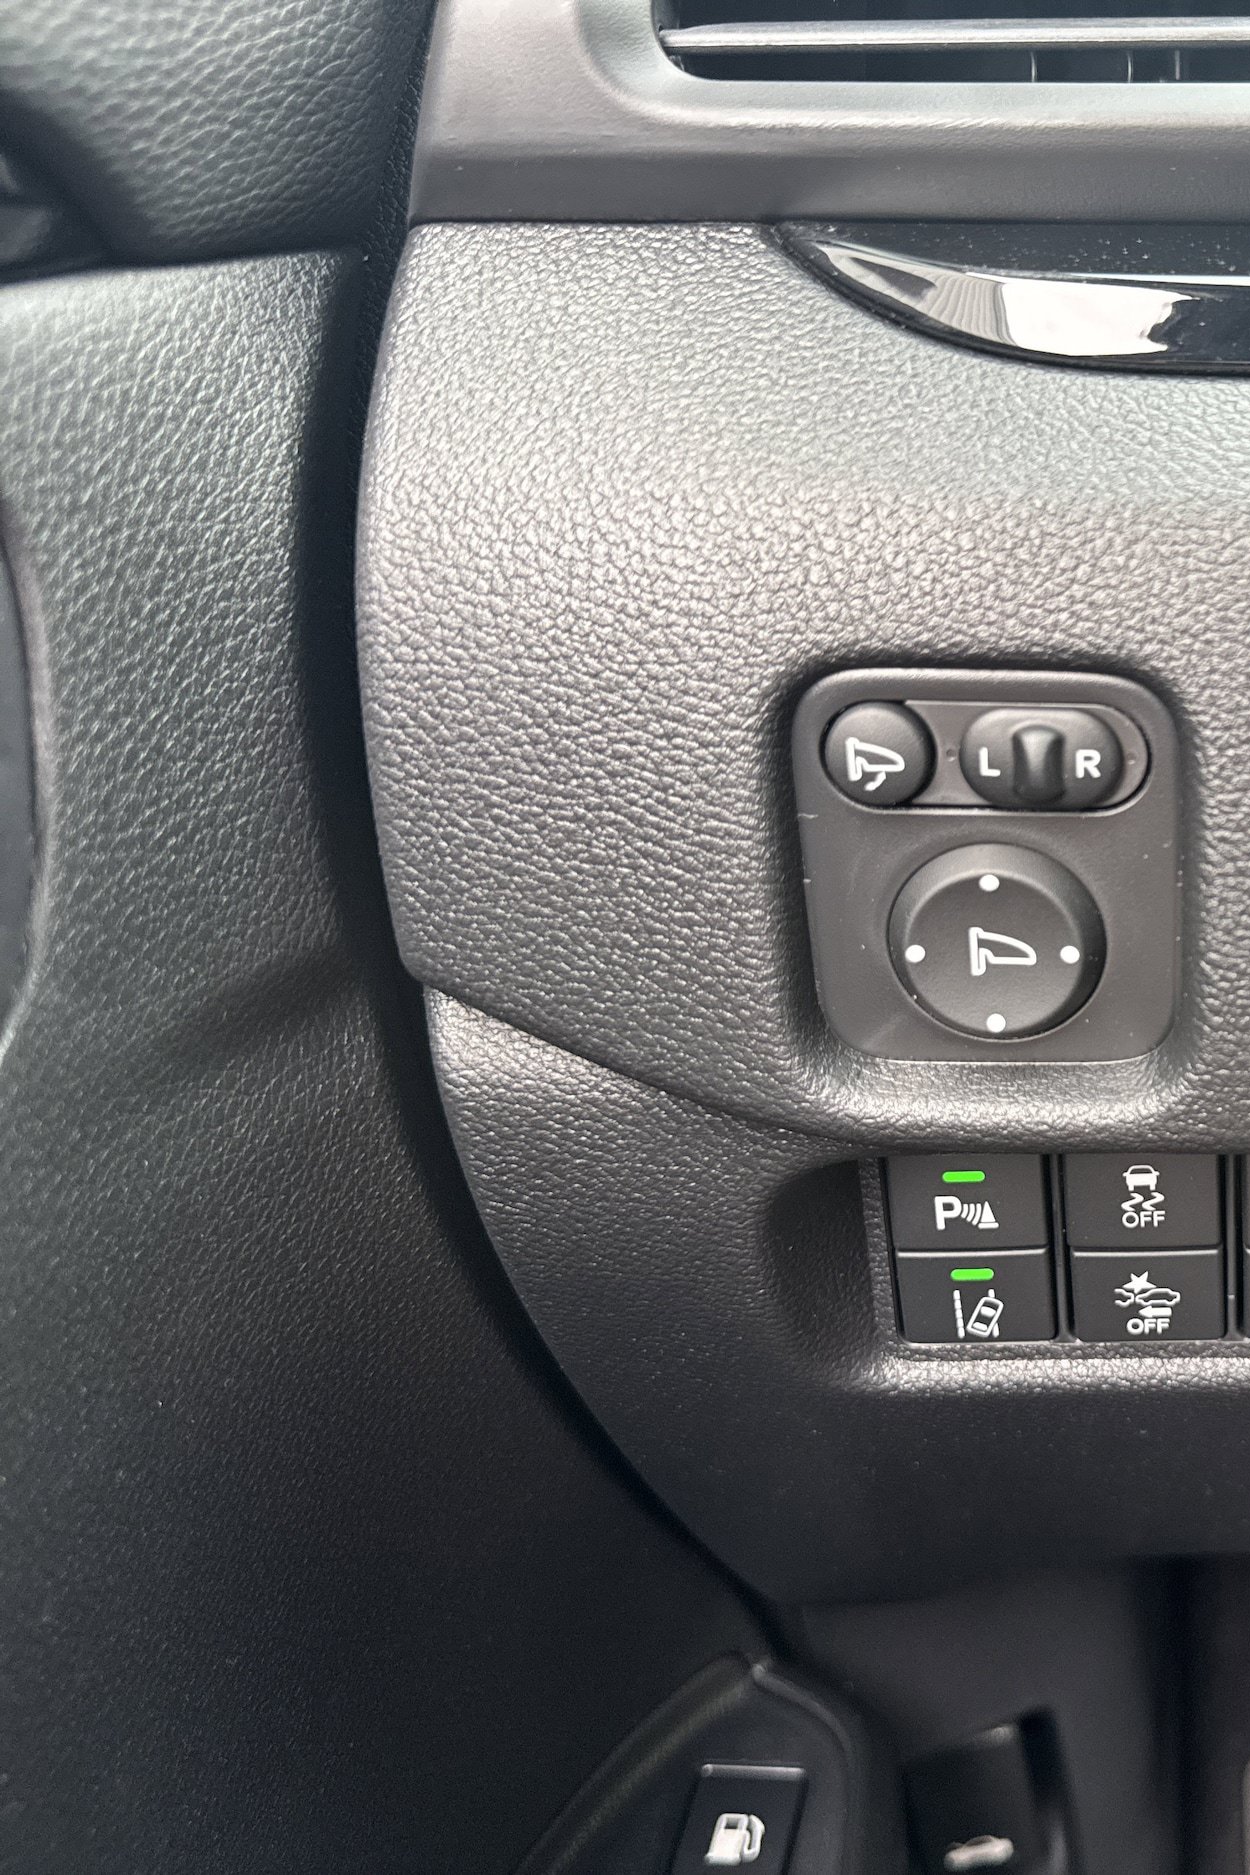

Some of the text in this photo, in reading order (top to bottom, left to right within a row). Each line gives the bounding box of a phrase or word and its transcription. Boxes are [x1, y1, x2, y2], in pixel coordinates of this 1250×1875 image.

[978, 746, 1001, 777] L
[1075, 748, 1101, 779] R
[1121, 1209, 1166, 1229] OFF
[1126, 1316, 1171, 1336] OFF
